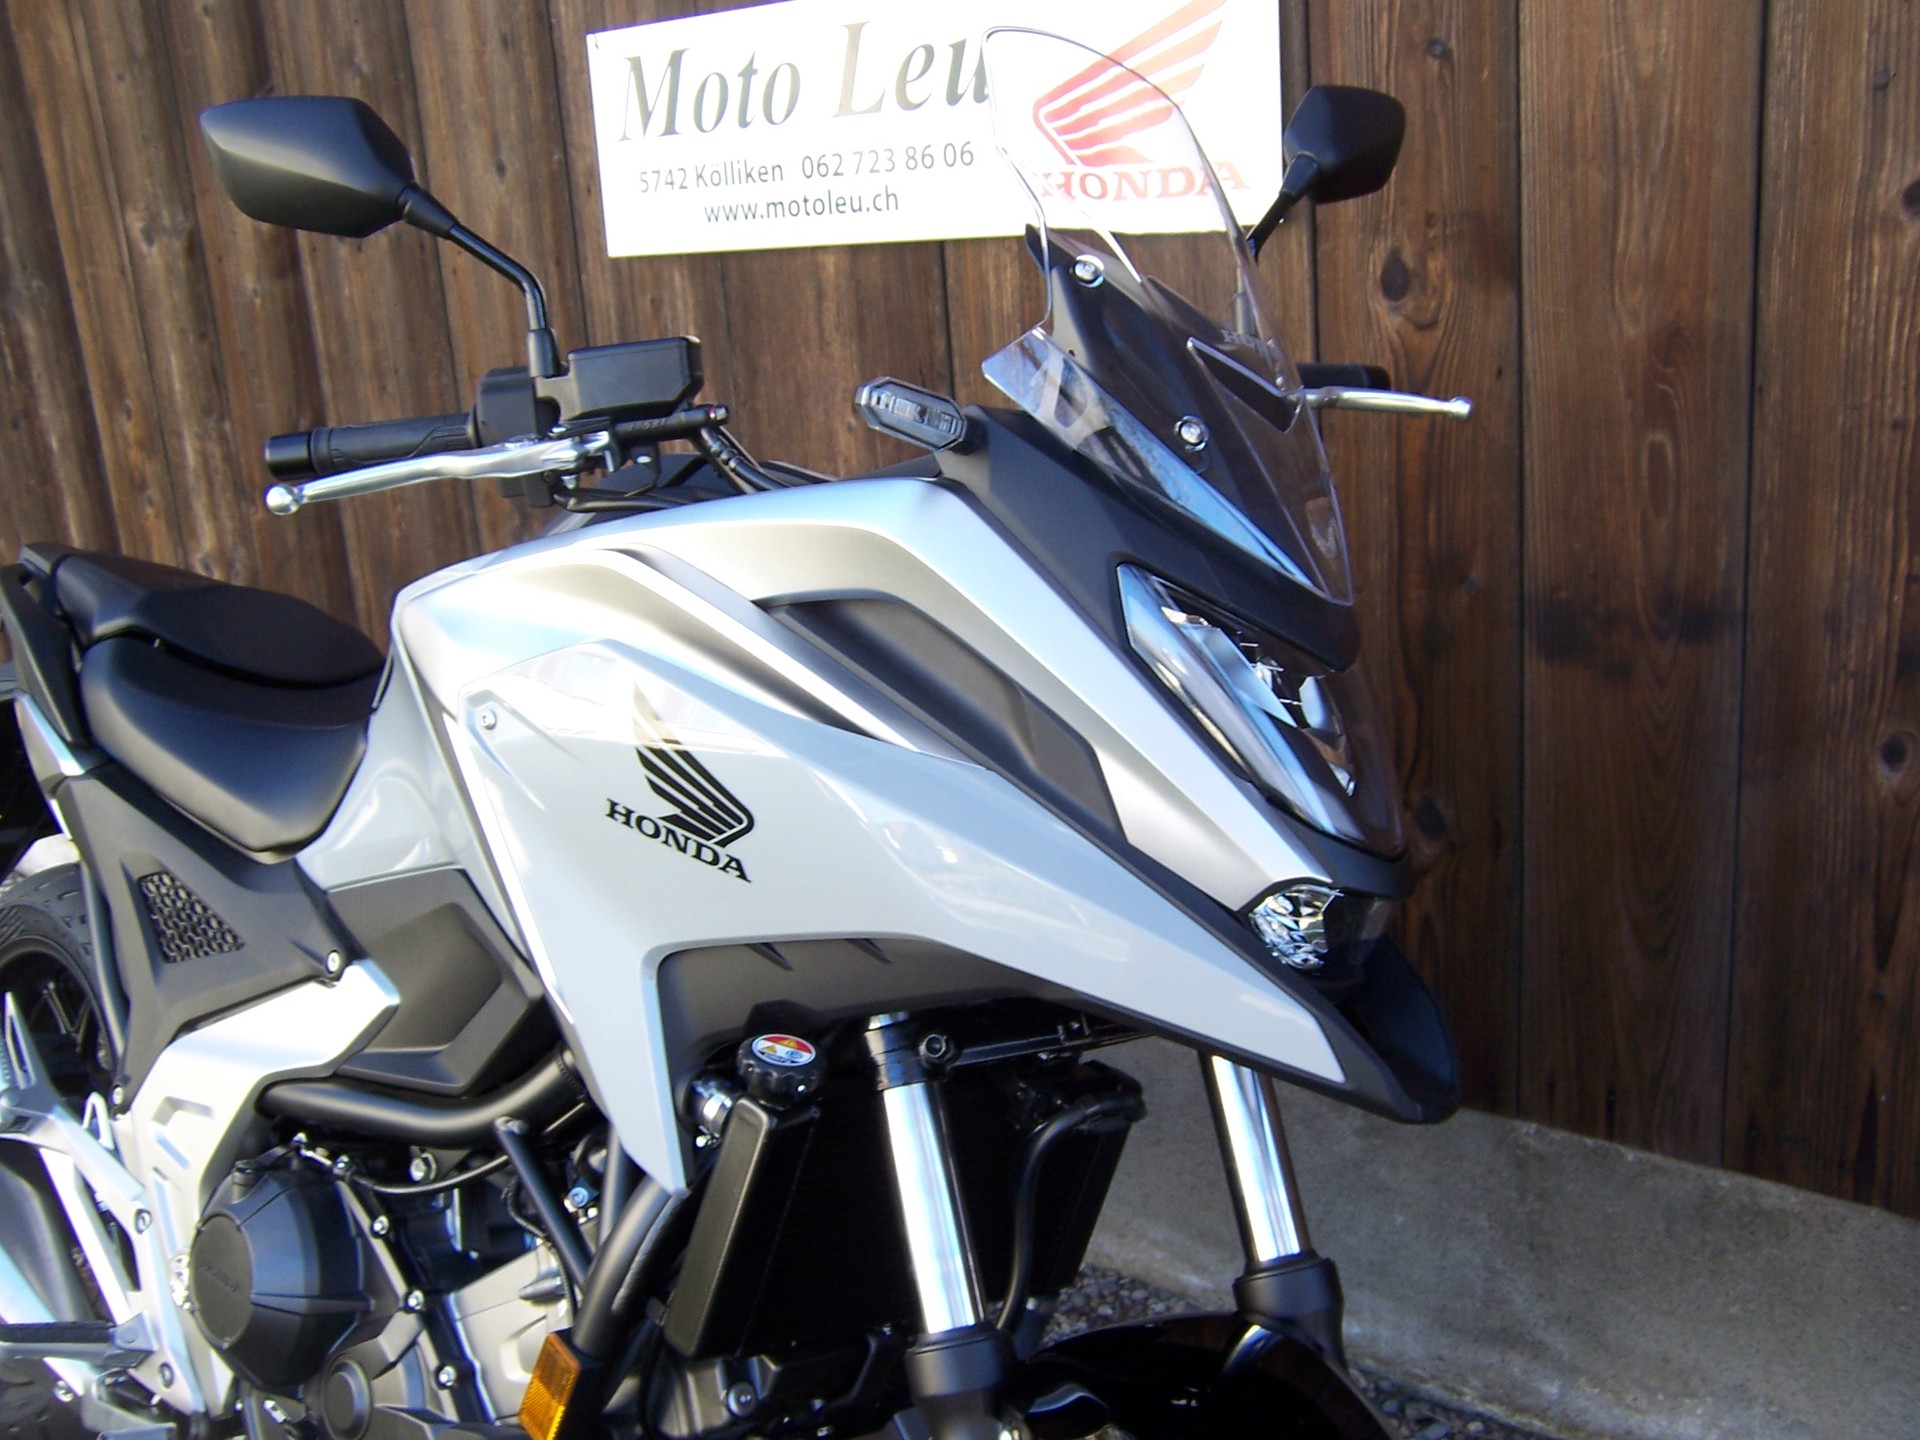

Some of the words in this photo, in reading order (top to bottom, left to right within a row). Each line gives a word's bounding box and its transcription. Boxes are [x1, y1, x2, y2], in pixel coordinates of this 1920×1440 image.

[617, 47, 801, 142] Moto
[831, 20, 990, 118] Leu
[639, 167, 688, 193] 5742
[694, 159, 784, 188] Kölliken
[802, 154, 844, 179] 062
[852, 147, 896, 175] 723
[905, 144, 935, 171] 86
[943, 140, 974, 168] 06
[1041, 160, 1250, 201] HONDA
[703, 184, 899, 223] www.motoleu.ch
[605, 797, 752, 884] HONDA
